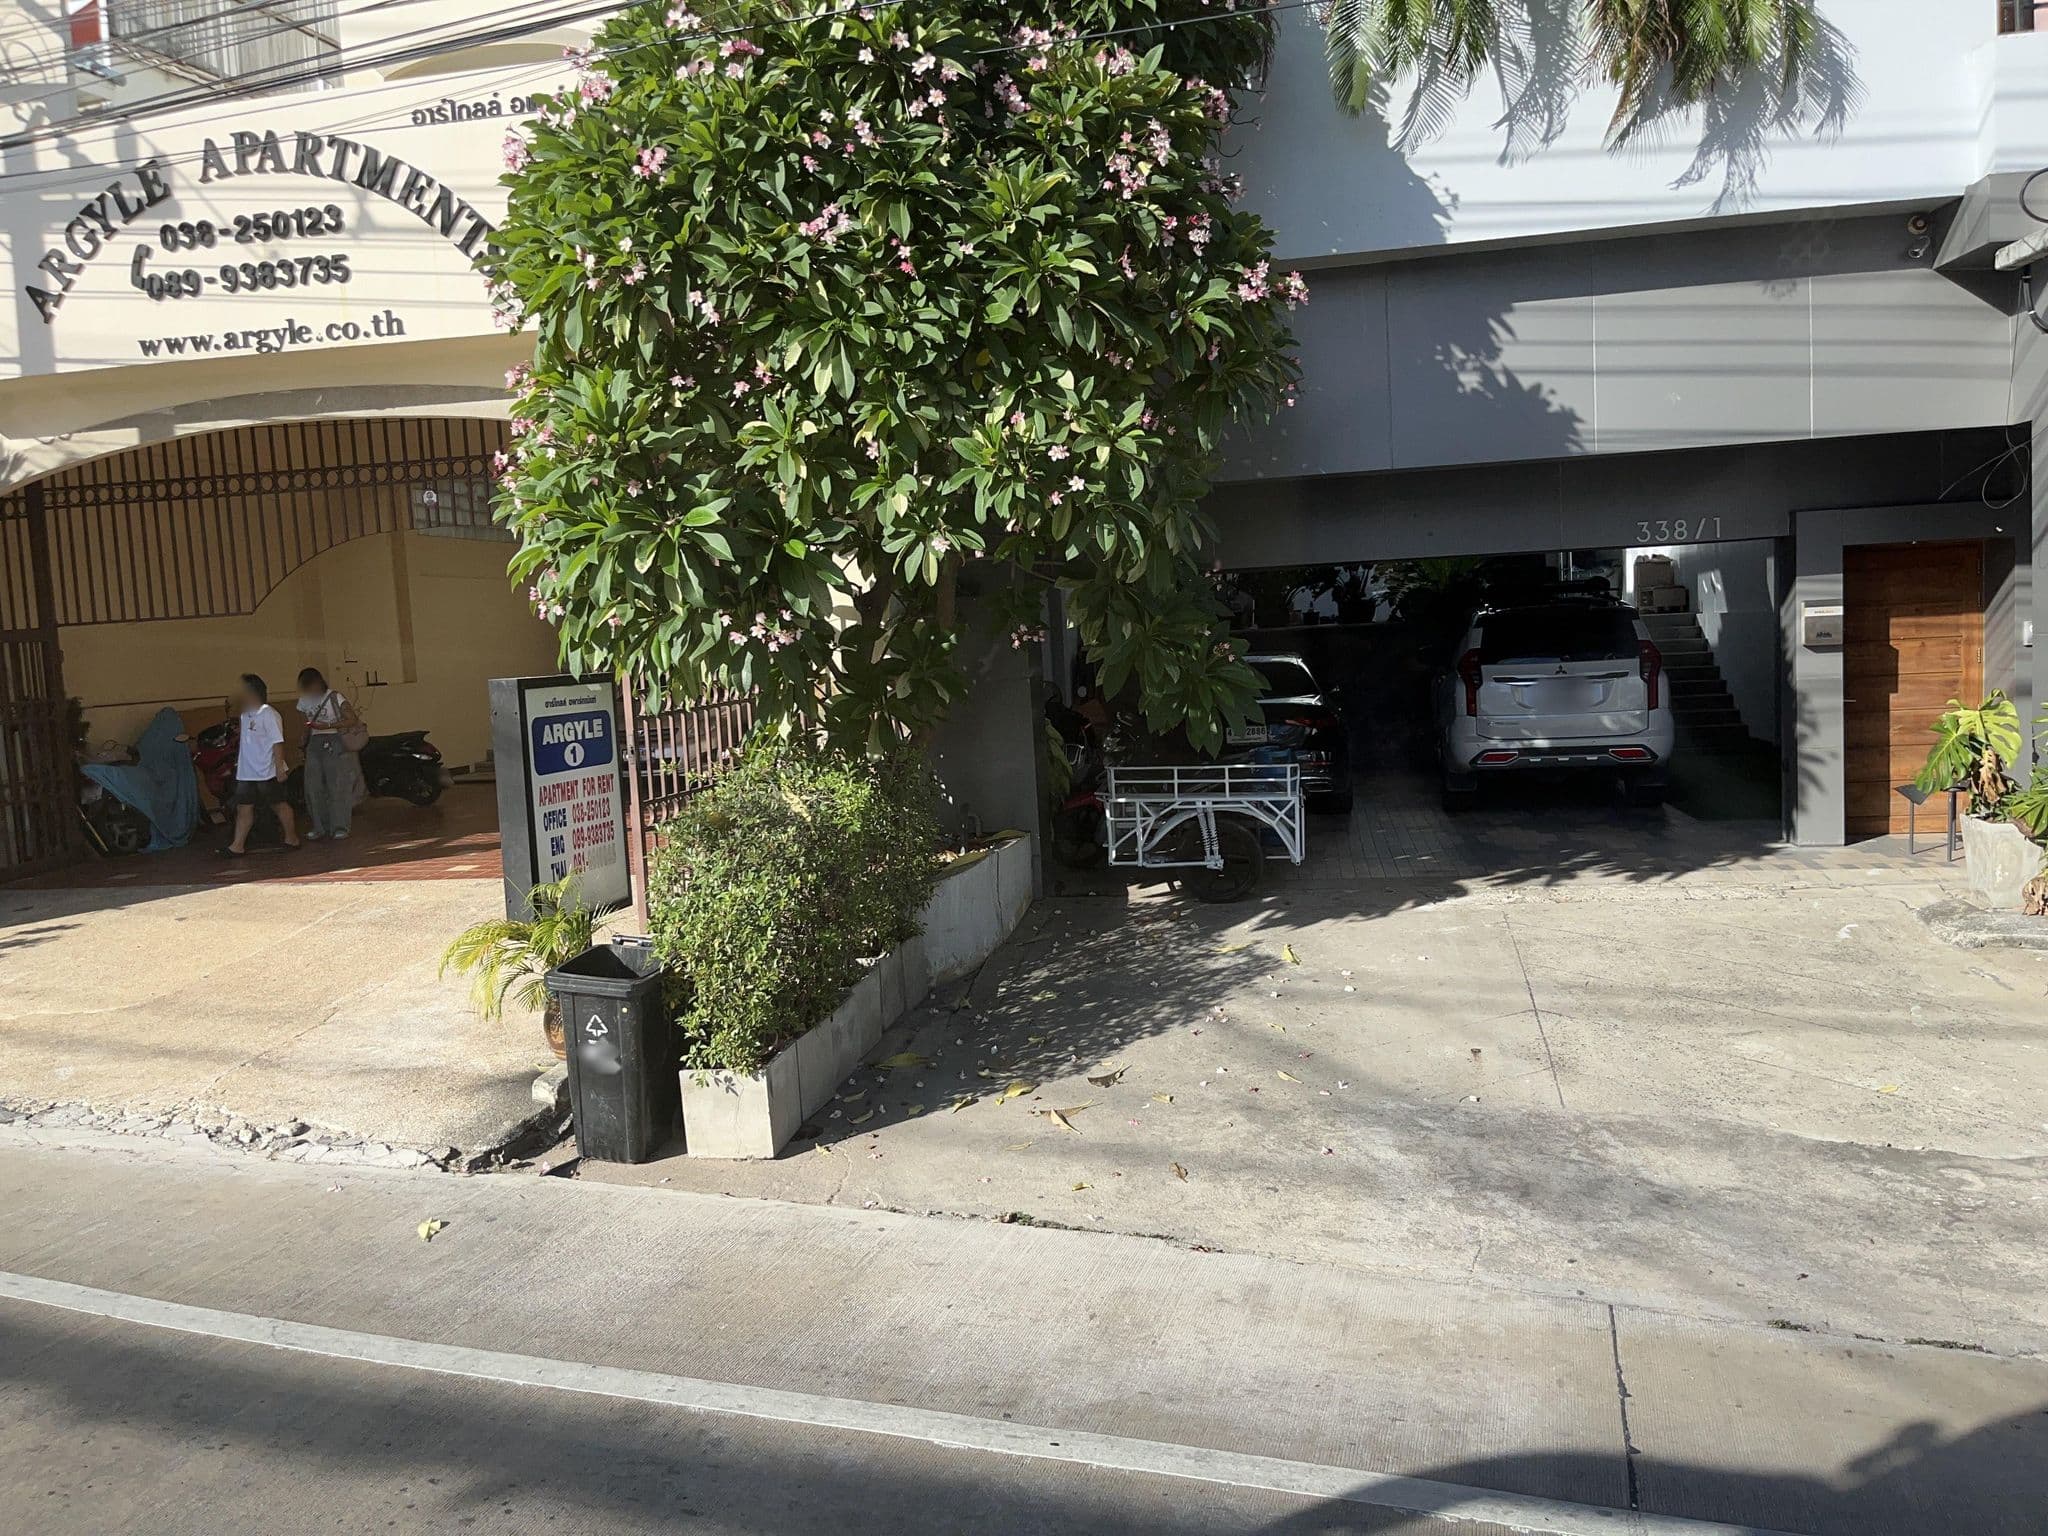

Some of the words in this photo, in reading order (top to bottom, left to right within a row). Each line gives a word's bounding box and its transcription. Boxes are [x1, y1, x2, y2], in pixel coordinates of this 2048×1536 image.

[26, 159, 171, 324] ARGYLE
[160, 204, 344, 251] 038-250123
[146, 254, 351, 300] 089-9383735
[138, 309, 405, 356] www.argyle.co.th
[1636, 517, 1721, 542] 338/1
[542, 718, 603, 745] ARGYLE
[570, 746, 577, 763] 1
[539, 780, 578, 807] APARTMENT
[583, 777, 596, 797] FOR
[598, 774, 614, 794] RENT
[543, 808, 568, 832] OFFICE
[551, 835, 565, 856] ENG
